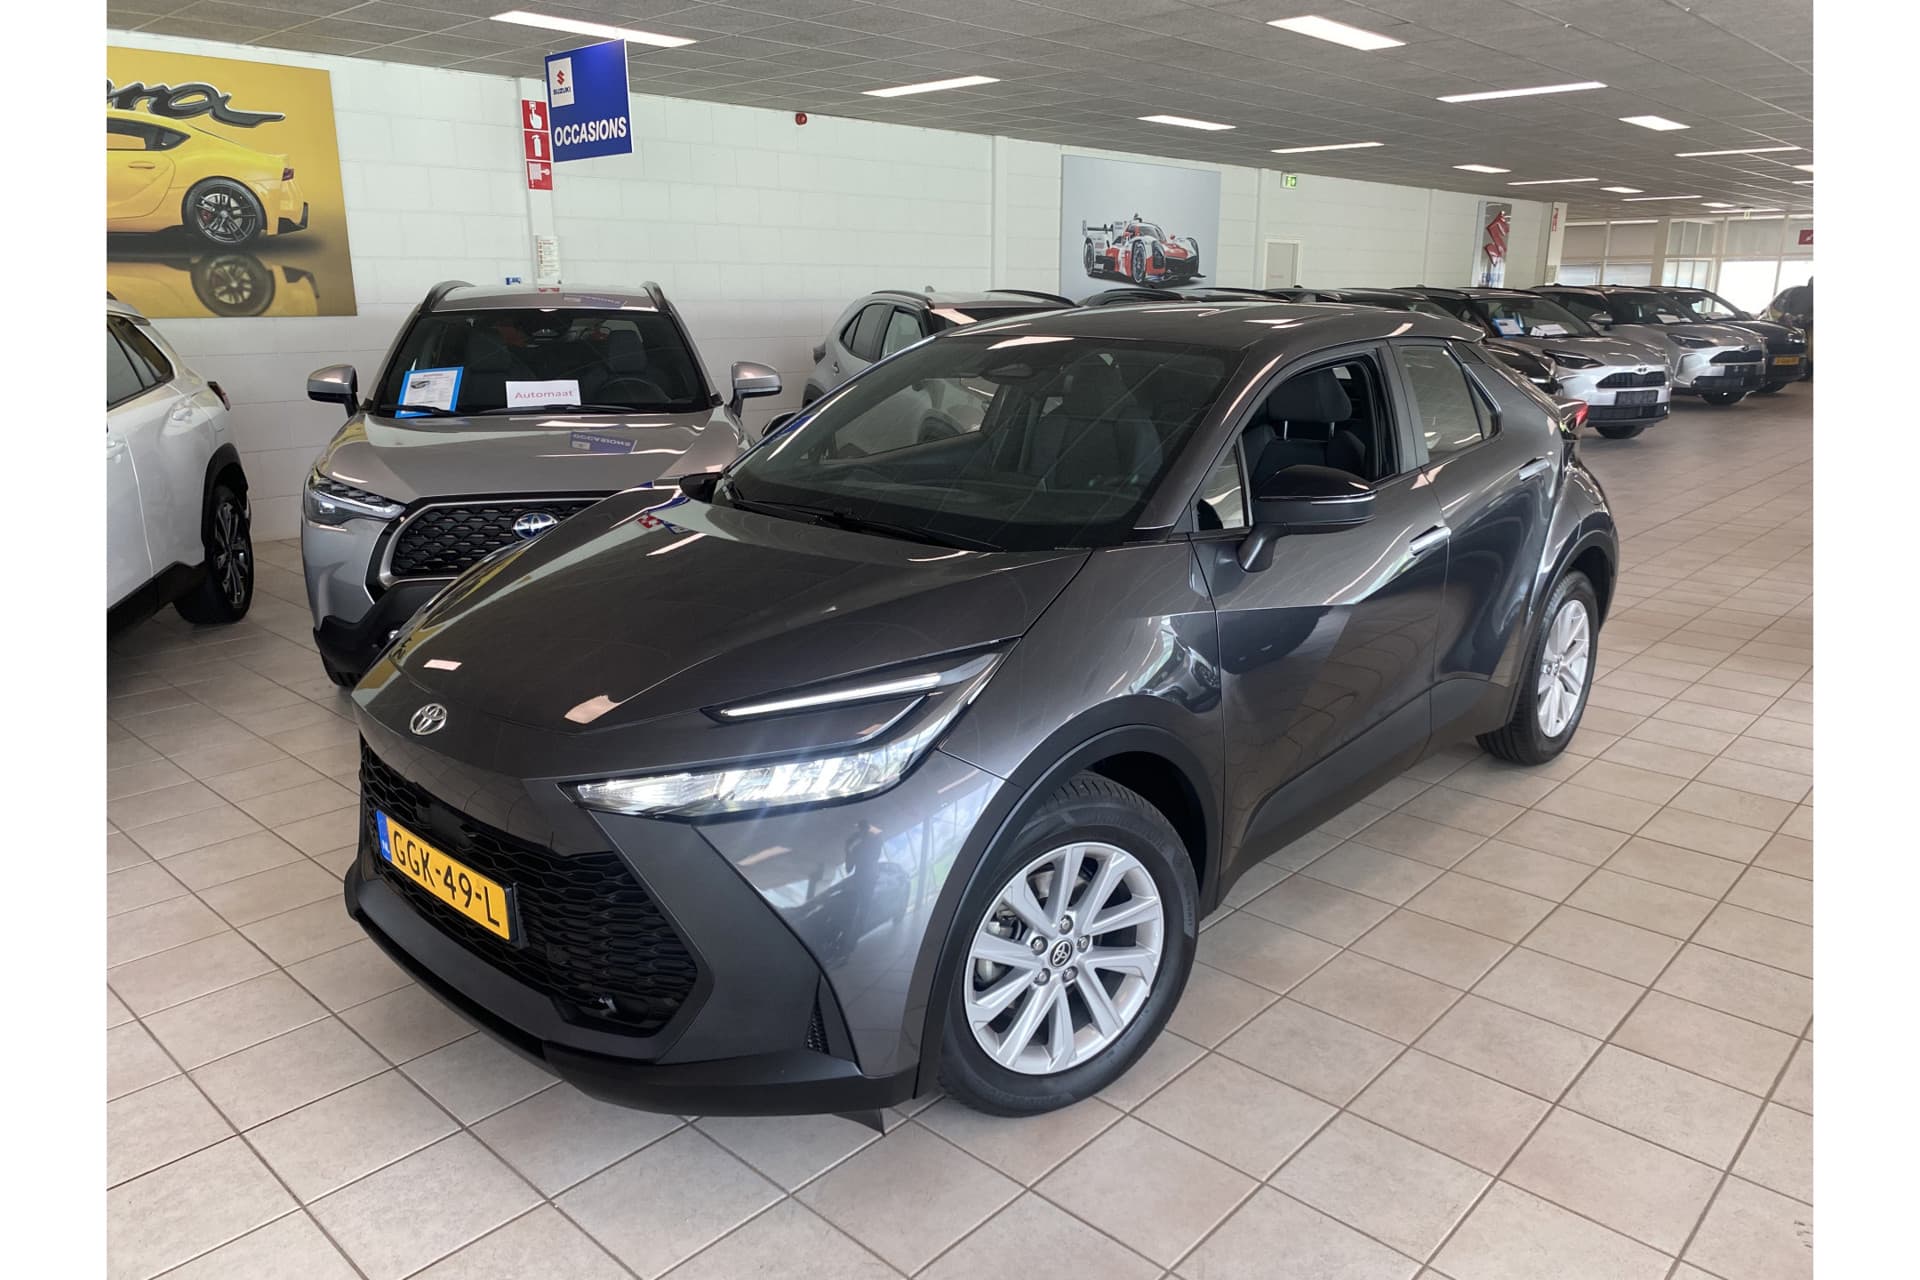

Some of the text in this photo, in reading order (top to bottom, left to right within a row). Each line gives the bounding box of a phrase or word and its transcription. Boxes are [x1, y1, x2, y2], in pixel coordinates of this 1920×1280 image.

[554, 116, 627, 147] OCCASIONS
[514, 390, 574, 400] Automaat
[393, 830, 501, 928] GGK-49-L
